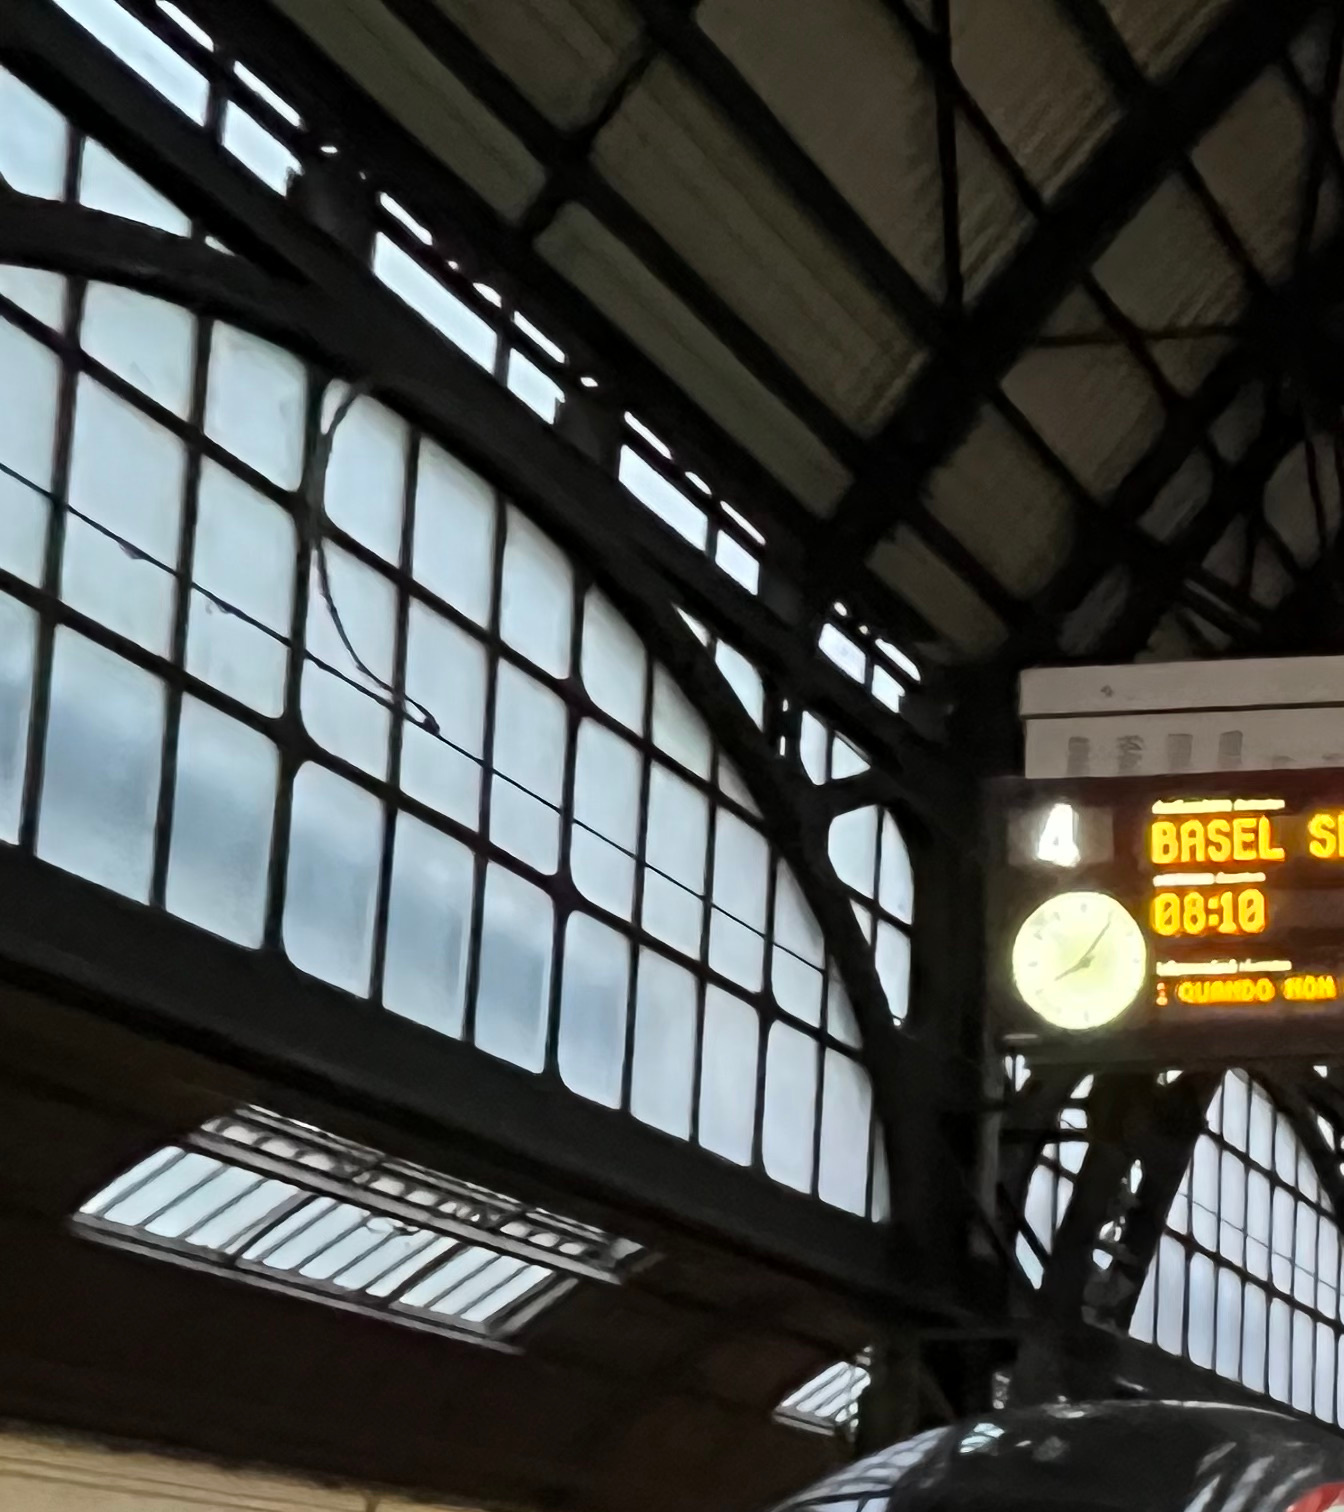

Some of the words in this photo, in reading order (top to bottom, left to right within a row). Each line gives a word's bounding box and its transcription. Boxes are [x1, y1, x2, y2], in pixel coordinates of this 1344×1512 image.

[1037, 803, 1080, 867] 4
[1151, 815, 1285, 864] BASEL
[1154, 889, 1266, 936] 08:10
[1172, 975, 1275, 1004] QUANDO
[1281, 975, 1336, 1000] NON
